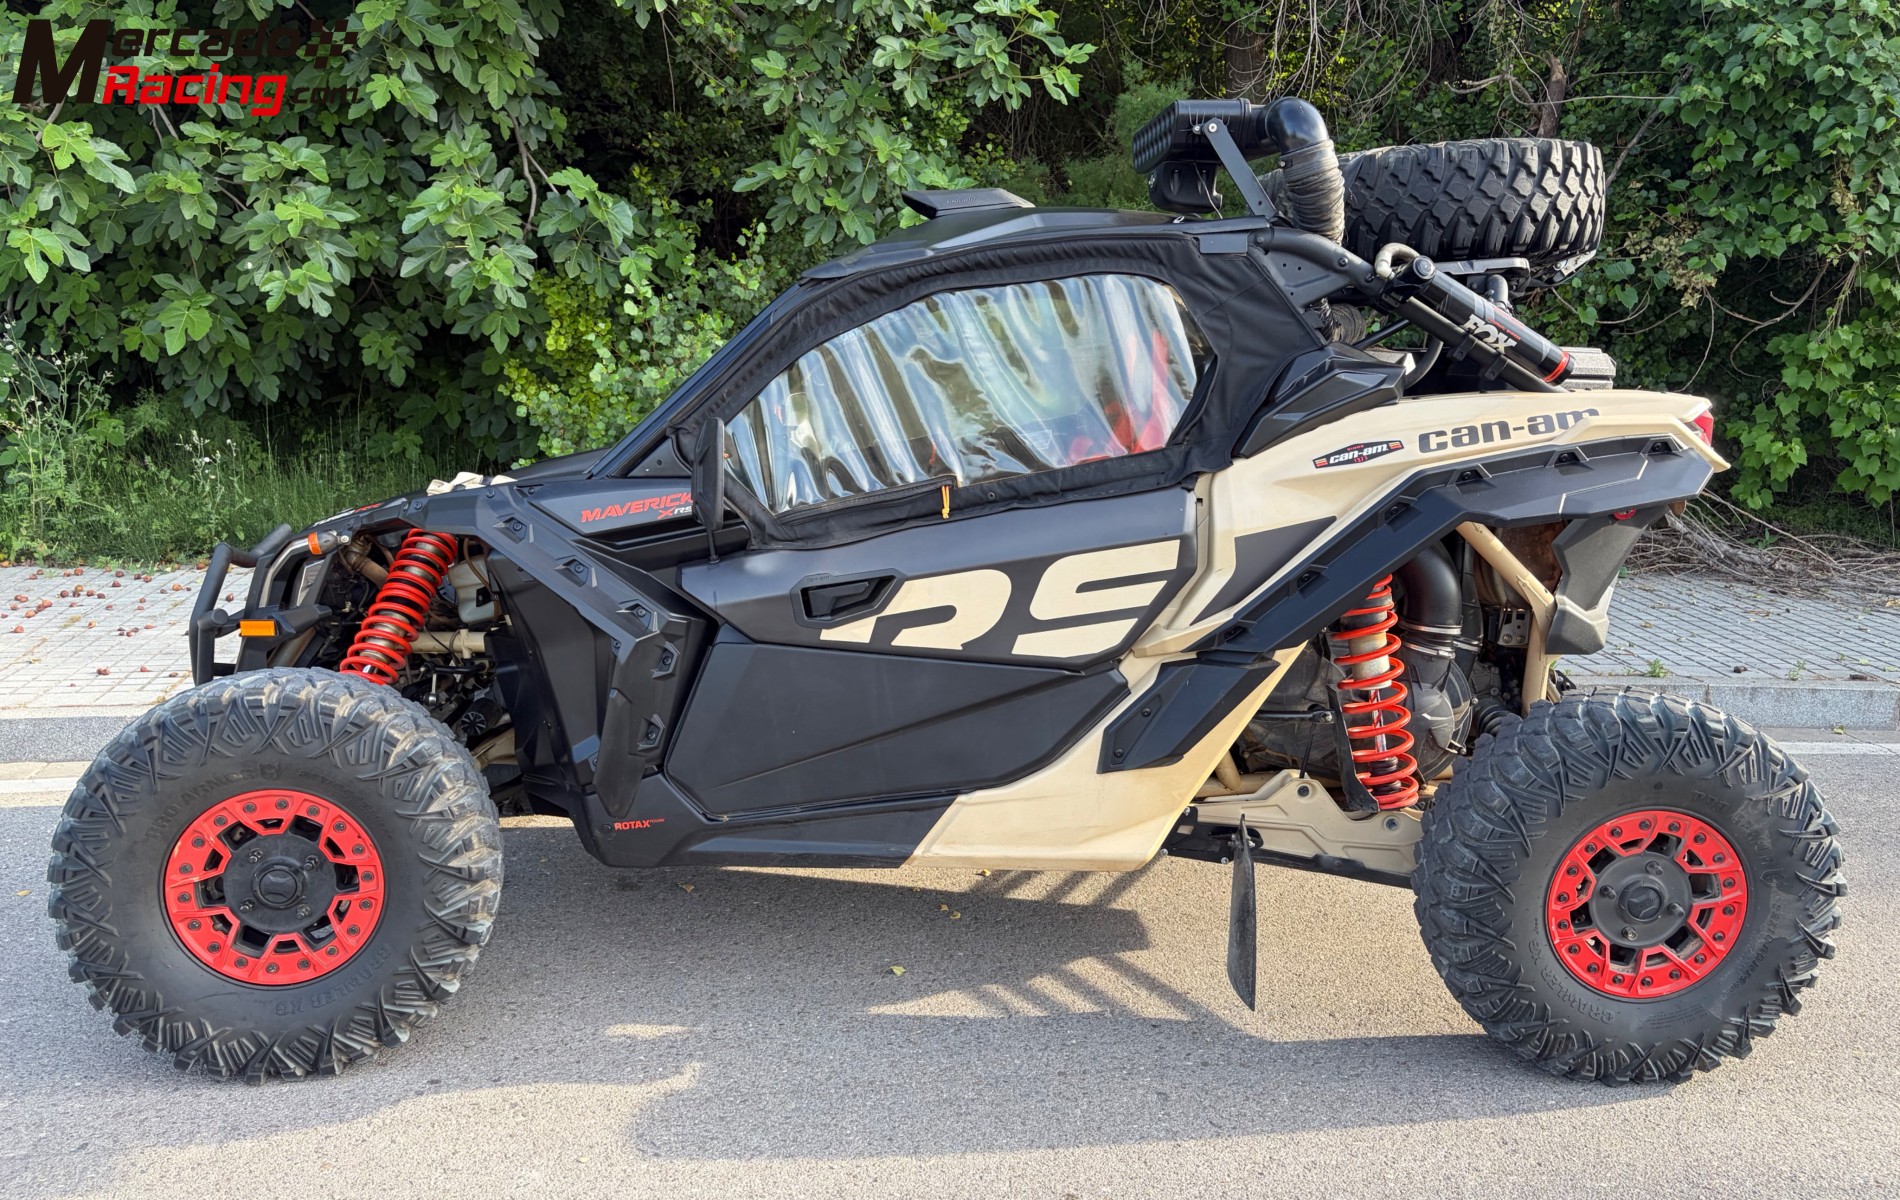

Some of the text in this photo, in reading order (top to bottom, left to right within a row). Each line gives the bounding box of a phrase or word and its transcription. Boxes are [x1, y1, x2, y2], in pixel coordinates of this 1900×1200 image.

[1460, 313, 1518, 355] FOX
[1329, 443, 1389, 464] can-am
[613, 820, 650, 830] ROTAX
